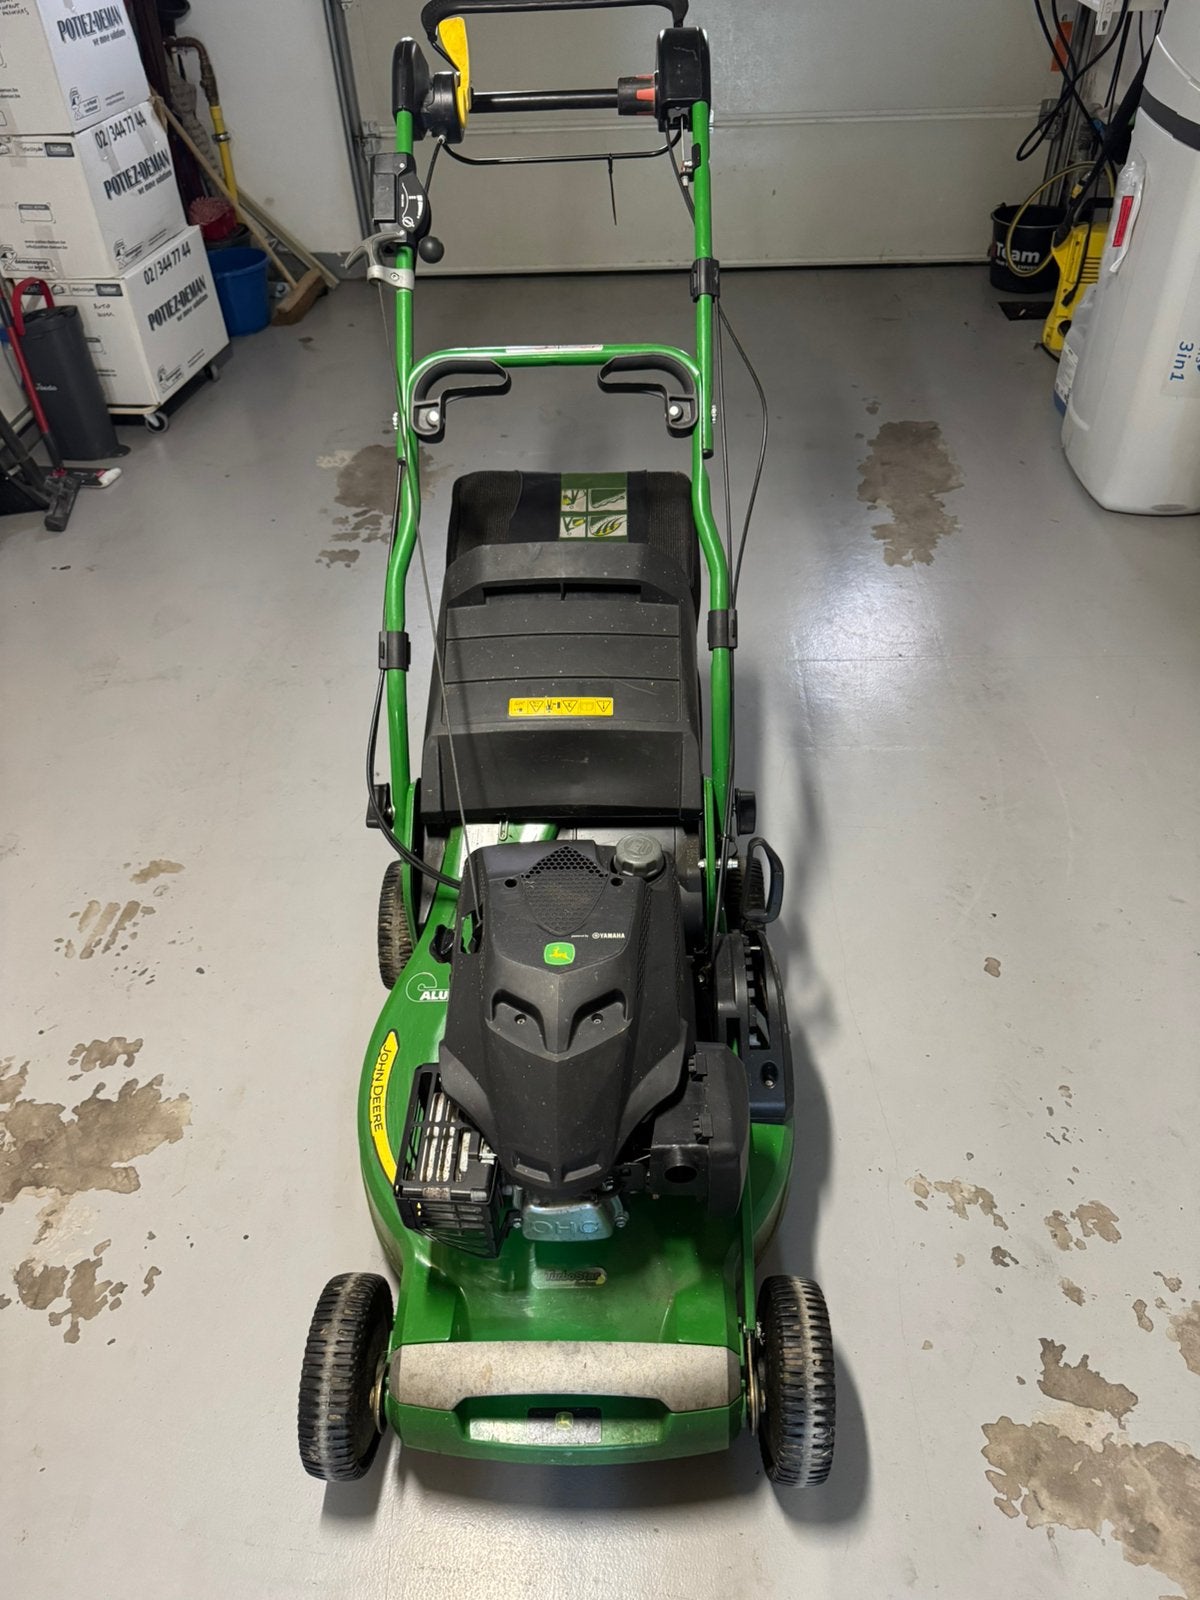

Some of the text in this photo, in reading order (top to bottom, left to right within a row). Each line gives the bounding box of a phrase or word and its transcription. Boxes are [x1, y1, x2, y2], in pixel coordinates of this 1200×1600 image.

[123, 115, 136, 133] 77
[134, 110, 147, 127] 44
[171, 247, 181, 265] 77
[181, 241, 191, 257] 44
[1169, 341, 1194, 381] 3in1
[419, 990, 449, 1001] ALU
[372, 1045, 392, 1132] JOHN DEERE
